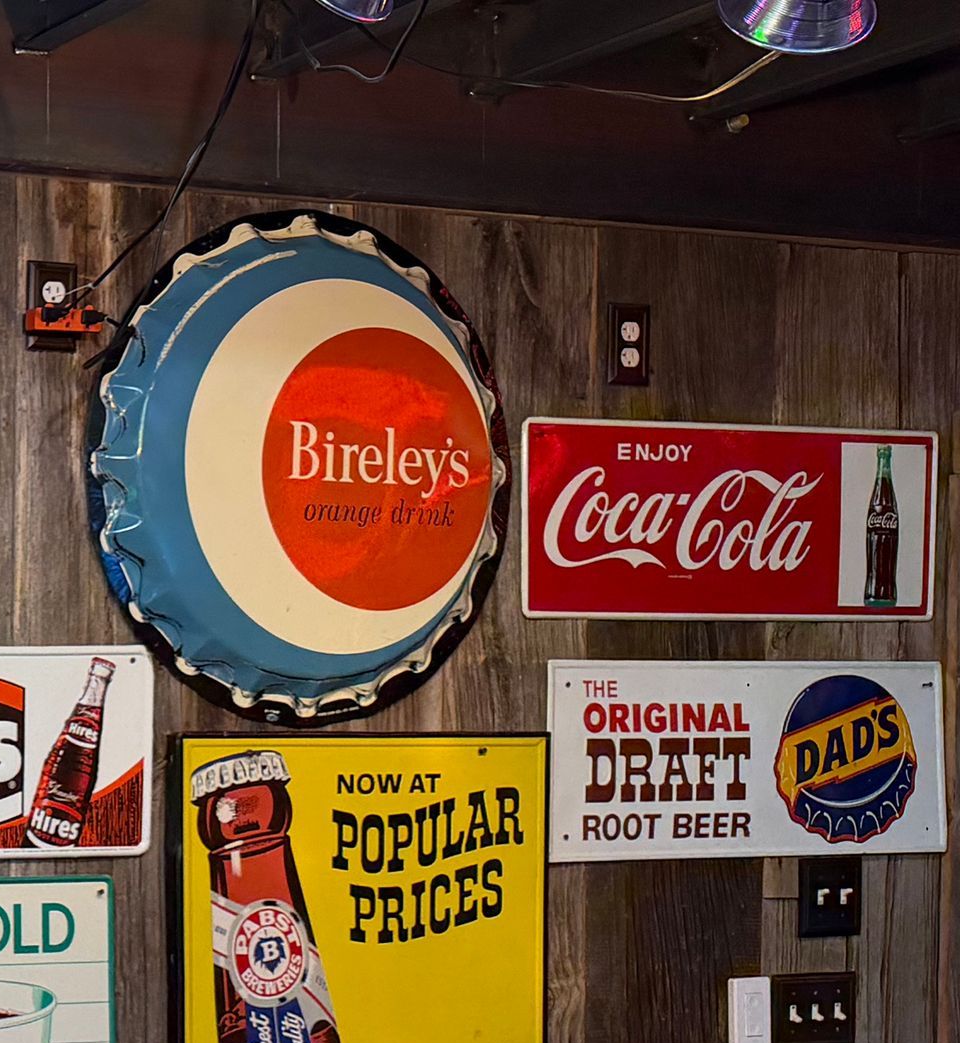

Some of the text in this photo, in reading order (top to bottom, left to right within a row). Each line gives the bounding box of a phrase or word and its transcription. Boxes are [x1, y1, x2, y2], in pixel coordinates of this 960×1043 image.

[288, 419, 470, 498] Bireley's
[617, 443, 693, 462] ENJOY
[304, 500, 455, 527] orange drink
[543, 467, 824, 571] Coca-Cola
[868, 511, 897, 529] Coca-Cola
[582, 680, 618, 699] THE
[68, 722, 99, 742] Hires
[583, 703, 751, 733] ORIGINAL
[795, 703, 900, 787] DAD'S
[337, 773, 440, 794] NOW AT
[585, 736, 751, 804] DRAFT
[30, 807, 80, 841] Hires
[331, 787, 524, 874] POPULAR
[582, 812, 751, 841] ROOT BEER
[349, 858, 504, 944] PRICES
[236, 910, 301, 955] PABST
[260, 941, 281, 963] B
[241, 954, 301, 994] BREWERIES
